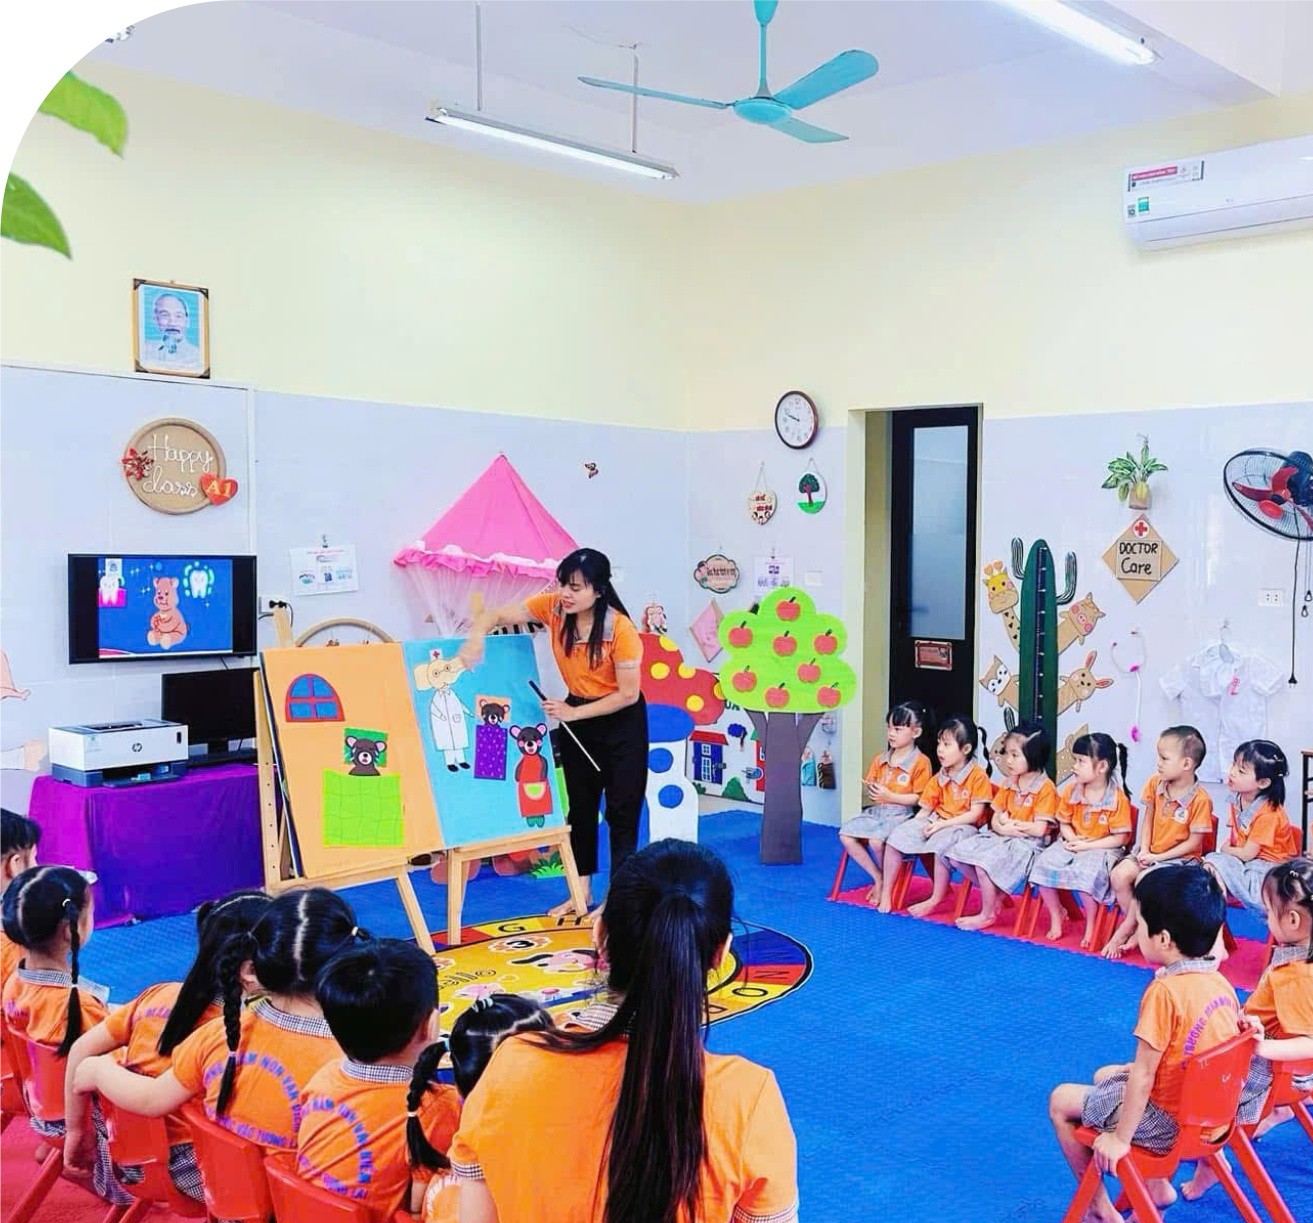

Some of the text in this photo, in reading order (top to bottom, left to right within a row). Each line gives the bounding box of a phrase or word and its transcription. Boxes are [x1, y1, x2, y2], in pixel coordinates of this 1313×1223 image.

[148, 434, 214, 473] Happy
[142, 466, 198, 498] class
[206, 480, 232, 497] A1
[1119, 542, 1158, 555] DOCTOR
[1121, 557, 1152, 575] Care
